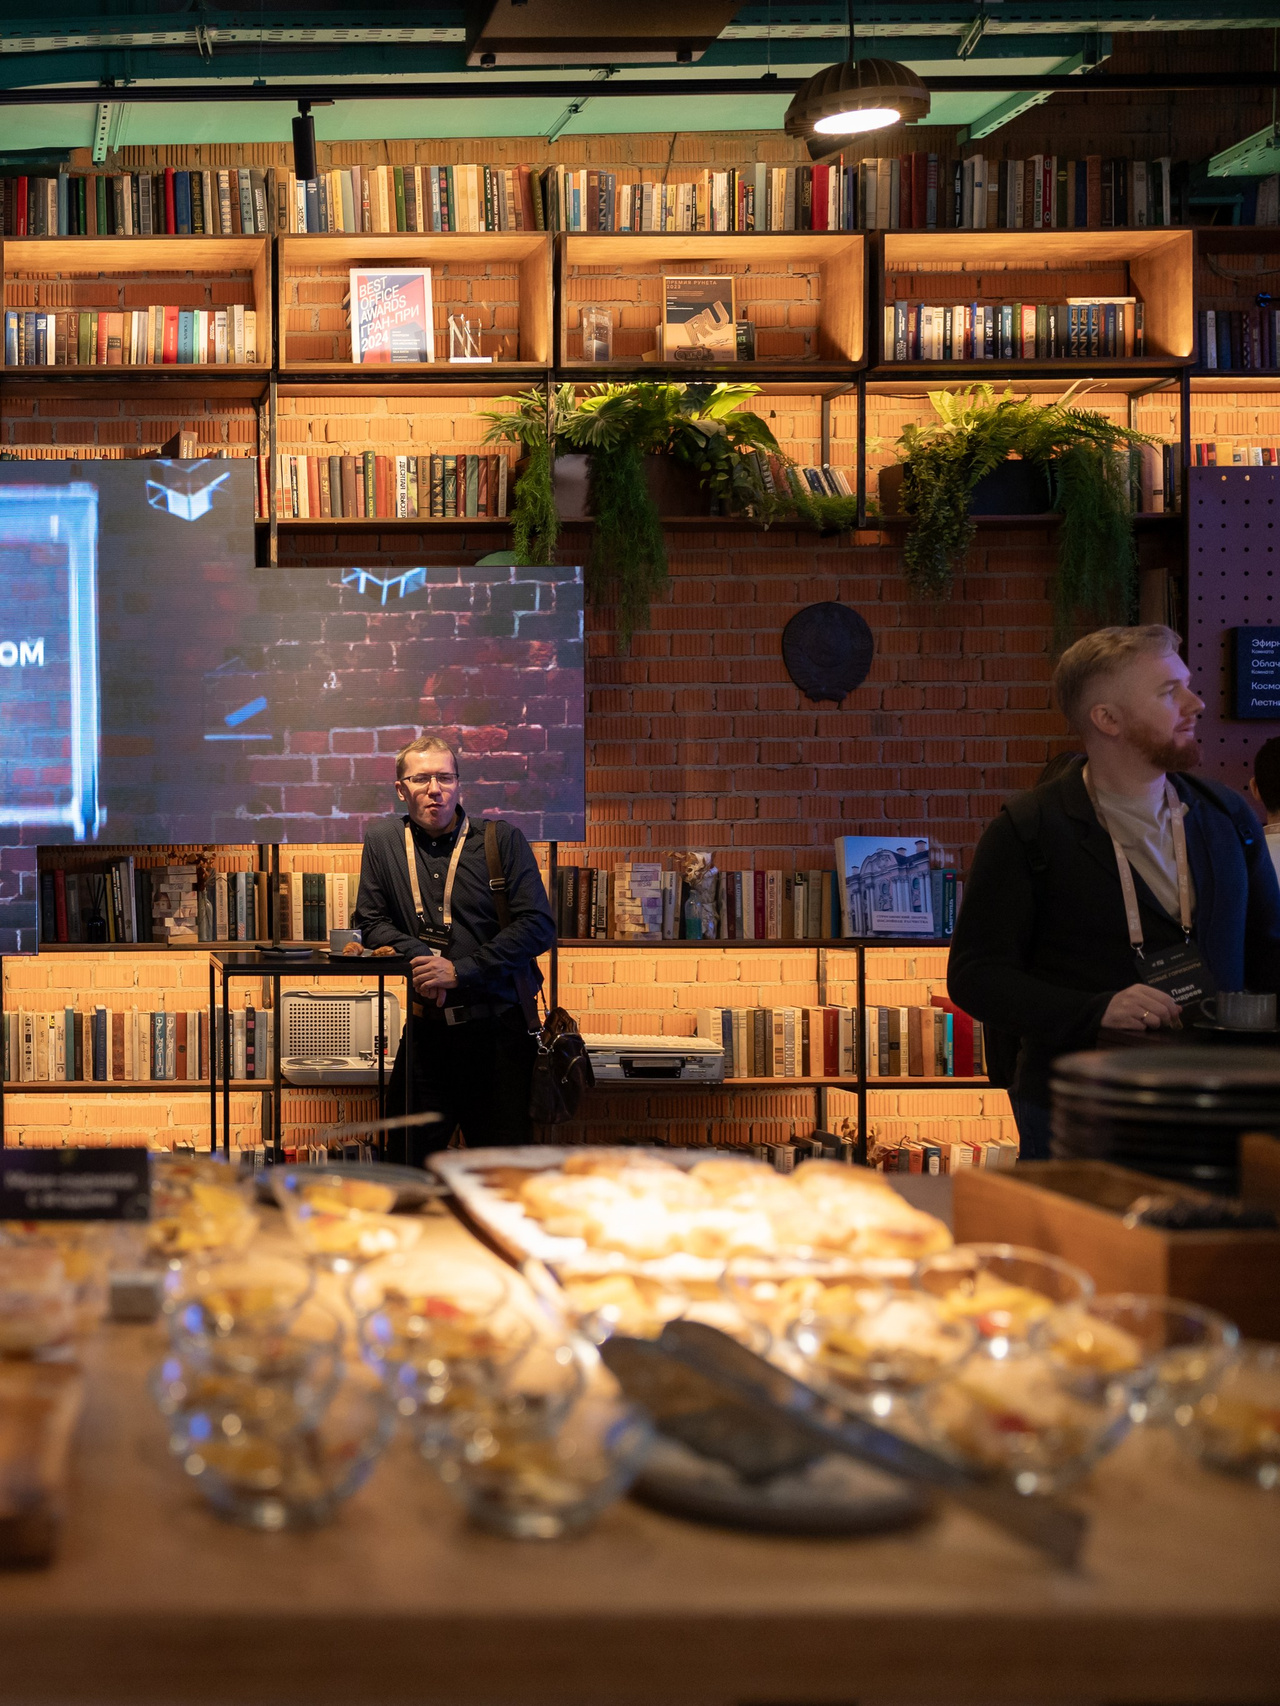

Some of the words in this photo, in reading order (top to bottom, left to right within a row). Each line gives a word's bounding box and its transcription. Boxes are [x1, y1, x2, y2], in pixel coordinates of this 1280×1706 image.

[359, 276, 388, 298] BEST
[360, 284, 400, 311] OFFICE
[361, 295, 407, 325] AWARDS
[361, 304, 420, 338] ГРАН-ПРИ
[684, 300, 730, 346] RU
[361, 330, 389, 353] 2024
[1251, 659, 1280, 667] Облач
[1251, 682, 1280, 690] Космо
[1170, 984, 1195, 997] Павел
[1173, 988, 1203, 1003] ндреев
